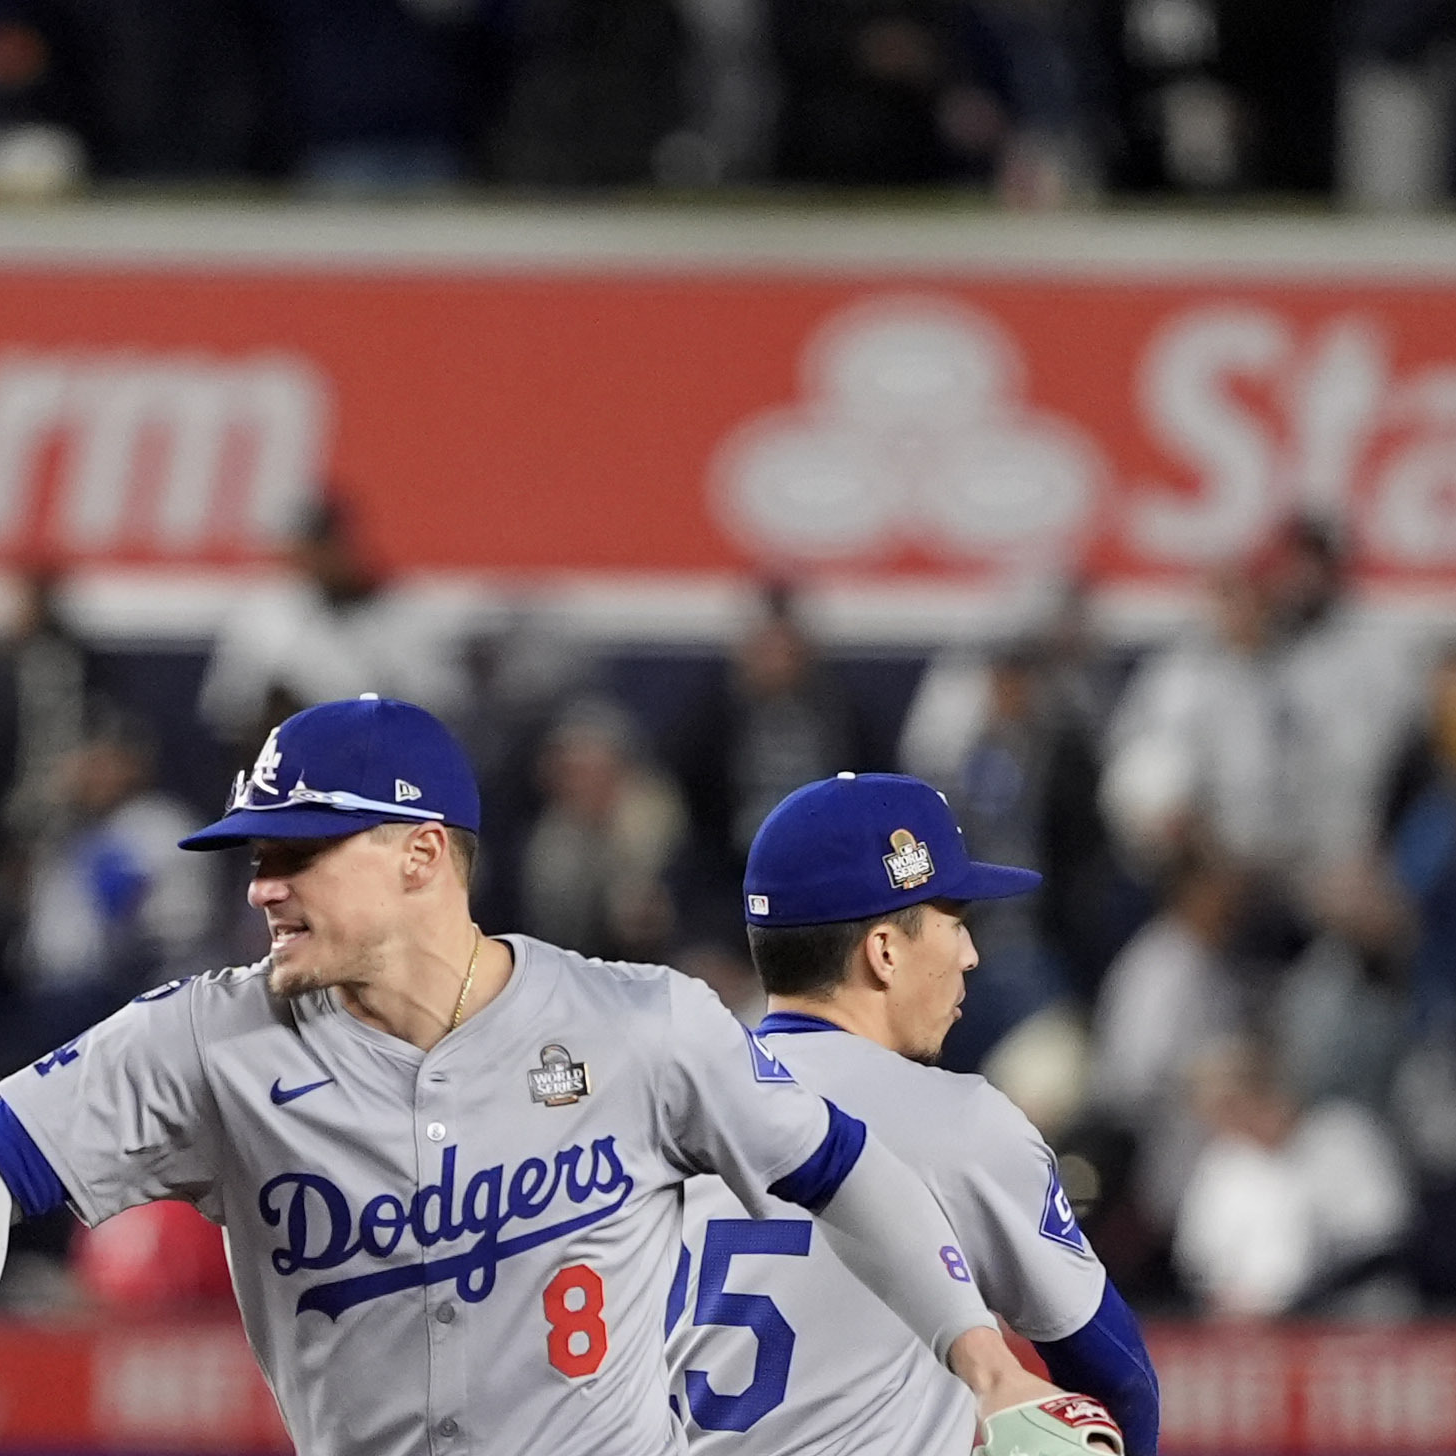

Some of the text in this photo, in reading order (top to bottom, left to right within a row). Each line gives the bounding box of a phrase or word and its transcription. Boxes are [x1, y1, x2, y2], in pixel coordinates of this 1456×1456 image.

[533, 1068, 584, 1084] WORLD
[536, 1079, 585, 1094] SERIES
[259, 1135, 634, 1305] Dodgers
[939, 1245, 971, 1283] 8
[543, 1263, 608, 1378] 8
[663, 1219, 812, 1433] 5
